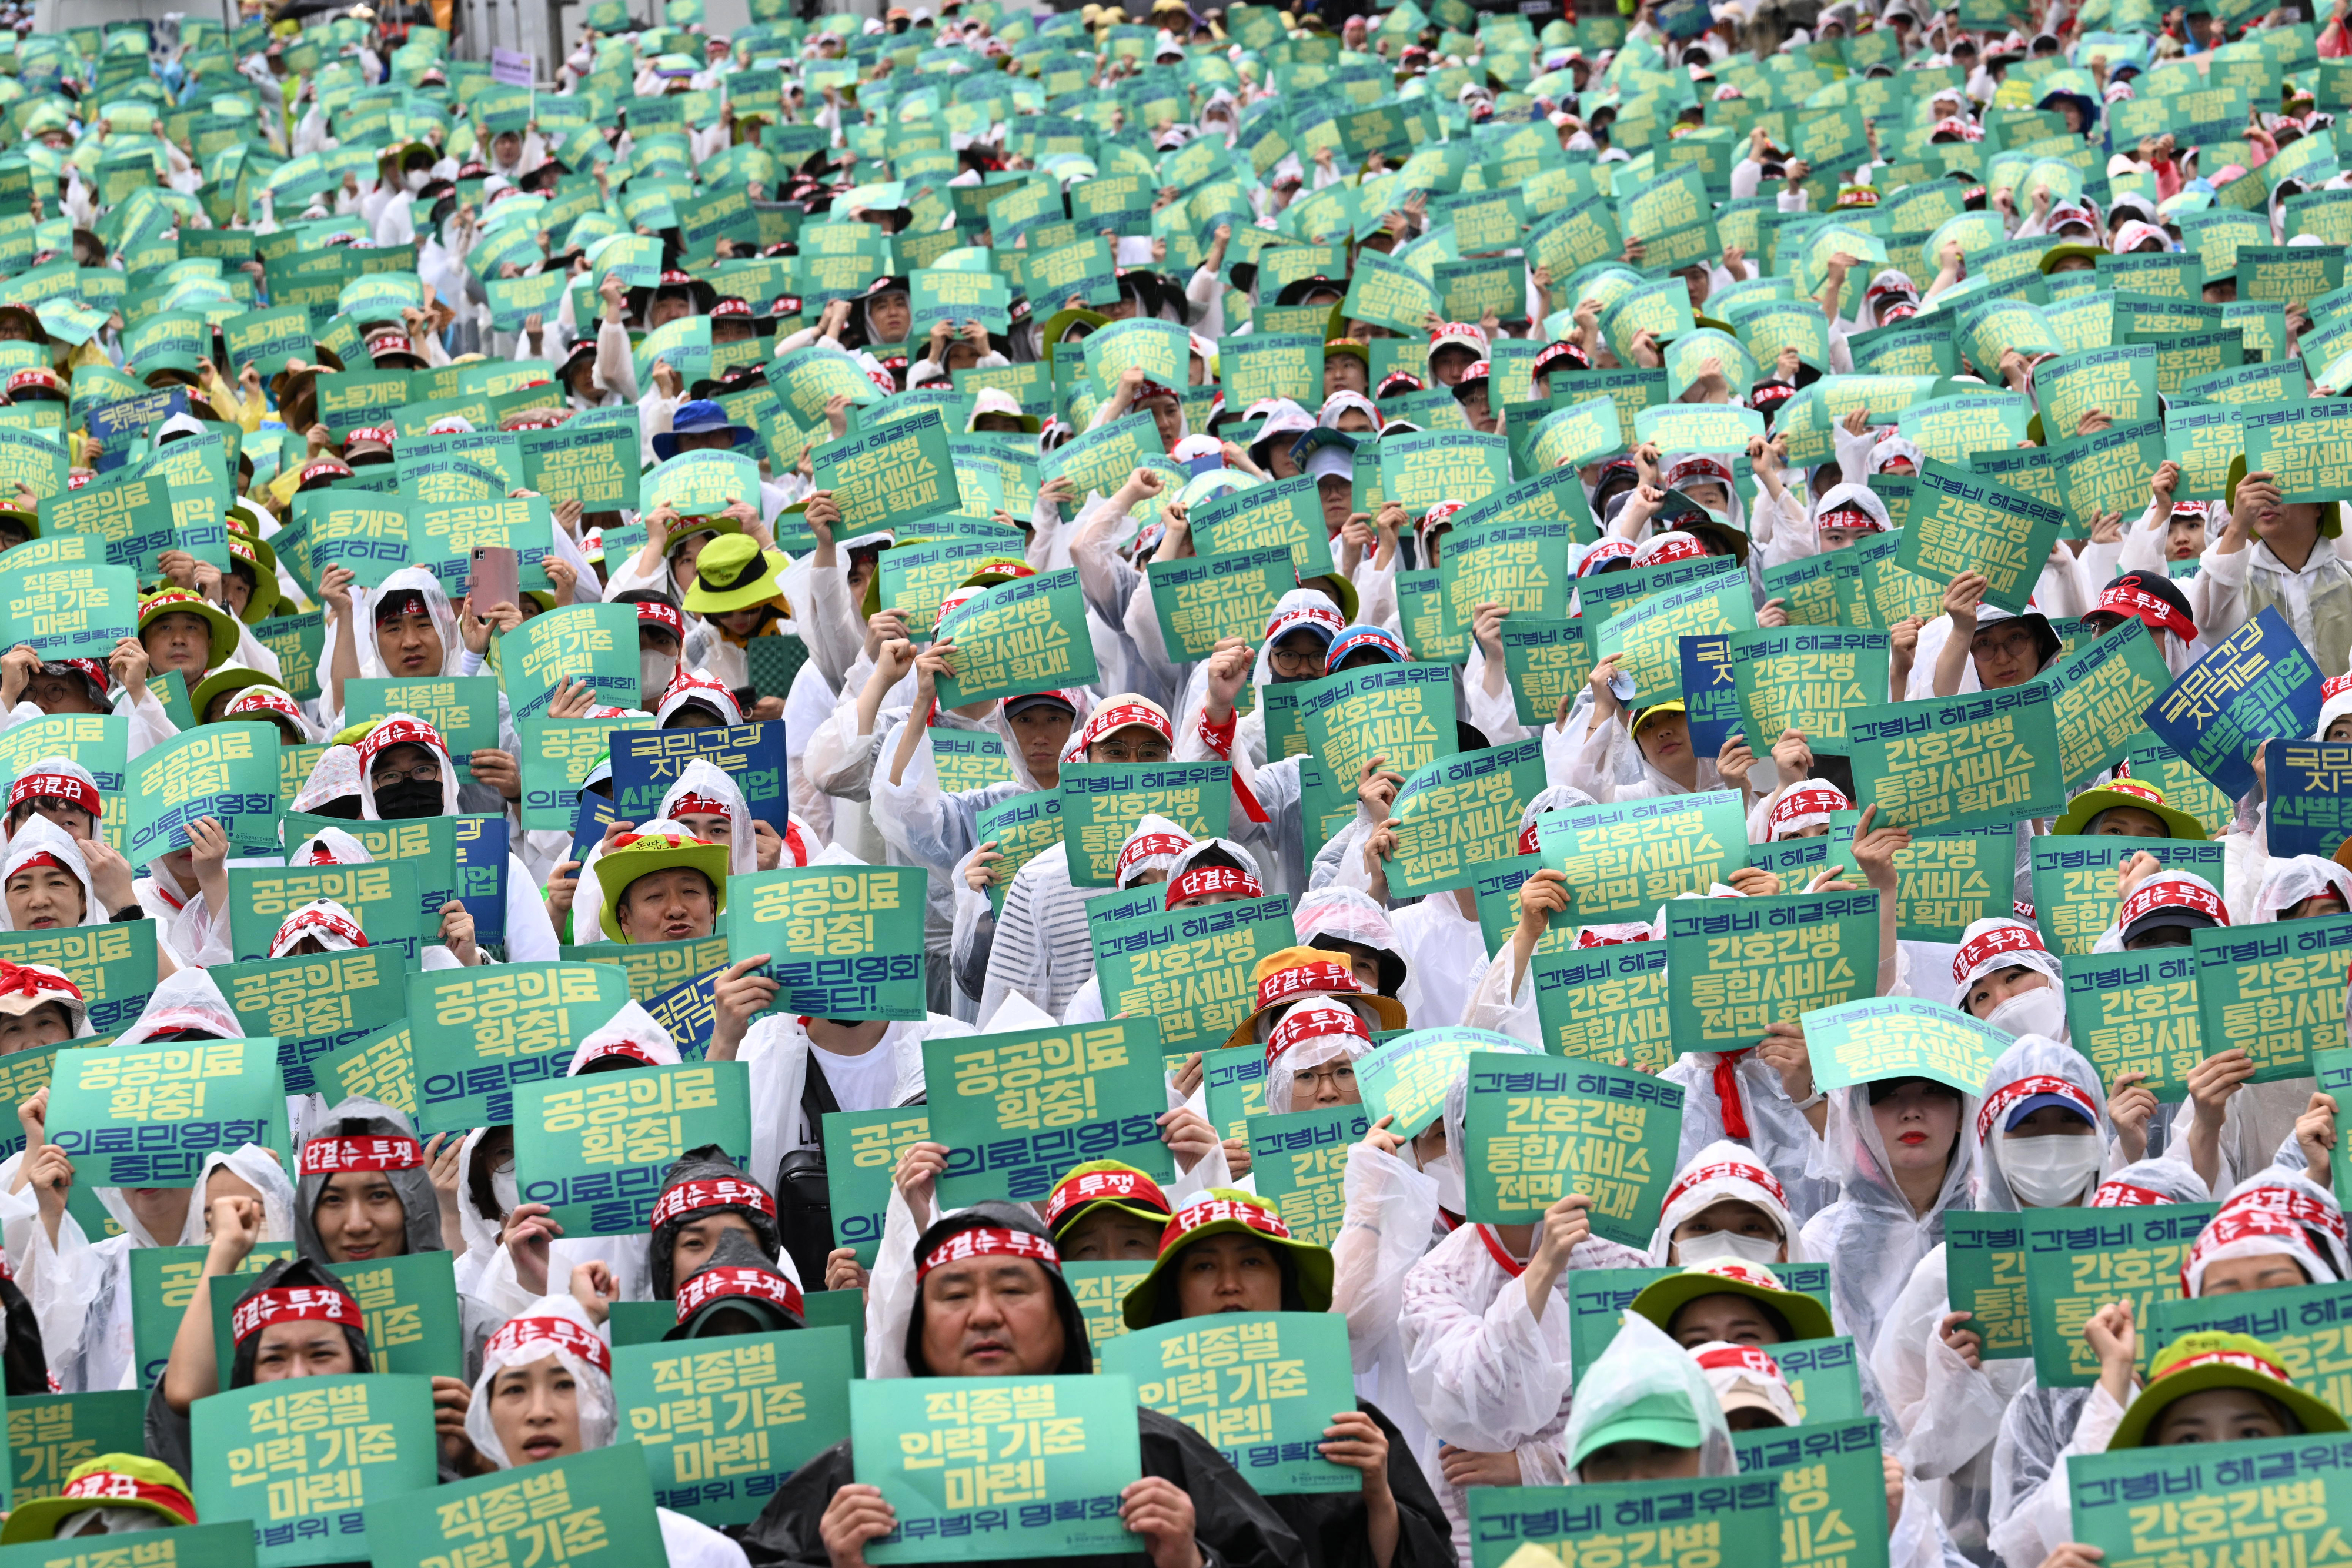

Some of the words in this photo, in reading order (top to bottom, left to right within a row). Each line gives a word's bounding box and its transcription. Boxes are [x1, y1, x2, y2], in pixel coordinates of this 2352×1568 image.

[2134, 314, 2203, 332] 간호간병
[964, 372, 1038, 393] 공공의료
[1238, 349, 1306, 375] 간호간병
[2038, 363, 2085, 385] 간병비
[2055, 363, 2131, 389] 간호간병
[325, 381, 407, 410] 노동개악
[2085, 417, 2166, 454] 해결위한
[2246, 408, 2304, 429] 간병비
[543, 444, 613, 467] 간호간병
[815, 440, 864, 471] 간병비
[869, 408, 941, 447] 해결위한
[836, 436, 920, 483] 간호간병
[834, 456, 938, 510] 통합서비스
[2070, 443, 2141, 484] 간호간병
[53, 482, 150, 529] 공공의료
[1506, 467, 1575, 505] 해결위한
[1922, 470, 1984, 502] 간병비
[1989, 493, 2066, 525] 해결위한
[425, 502, 530, 538] 공공의료
[843, 501, 886, 530] 전면
[889, 484, 939, 514] 확대!
[1936, 496, 2033, 543] 간호간병
[1490, 523, 1568, 542] 해결위한
[1668, 540, 1698, 557] 투쟁
[1918, 517, 2027, 570] 통합서비스
[1152, 566, 1207, 588] 간병비
[1212, 546, 1291, 574] 해결위한
[1458, 541, 1538, 571] 간호간병
[1917, 547, 1963, 575] 전면
[24, 569, 93, 593] 직종별
[988, 570, 1078, 604] 해결위한
[1175, 569, 1266, 604] 간호간병
[1451, 563, 1549, 594] 통합서비스
[10, 593, 56, 620] 인력
[62, 588, 109, 609] 기준
[34, 610, 87, 635] 마련!
[649, 604, 676, 624] 투쟁
[954, 596, 1051, 647] 간호간병
[2132, 592, 2170, 620] 투쟁
[256, 613, 322, 638] 해결위한
[528, 608, 597, 648] 직종별
[565, 630, 613, 658] 기준
[1734, 638, 1788, 663] 간병비
[1796, 634, 1889, 650] 해결위한
[957, 662, 1008, 696] 전면
[1009, 644, 1070, 680] 확대!
[1753, 653, 1855, 688] 간호간병
[2159, 618, 2263, 724] 국민건강
[1302, 681, 1354, 717] 간병비
[1361, 667, 1450, 690] 해결위한
[1325, 688, 1422, 735] 간호간병
[1748, 684, 1867, 721] 통합서비스
[2183, 653, 2270, 730] 지키는
[2190, 648, 2314, 774] 산별총파업
[1852, 713, 1932, 743] 간병비
[1939, 684, 2050, 725] 해결위한
[632, 723, 764, 758] 국민건강
[1885, 715, 2014, 777] 간호간병
[142, 732, 253, 801] 공공의료
[162, 762, 230, 807] 확충!
[1065, 775, 1133, 794] 간병비
[1142, 765, 1231, 787] 해결위한
[1875, 738, 2035, 808] 통합서비스
[1092, 788, 1200, 824] 간호간병
[1544, 810, 1623, 835] 간병비
[1632, 790, 1739, 818] 해결위한
[1881, 793, 1951, 830] 전면
[1957, 773, 2031, 813] 확대!
[1578, 811, 1704, 852] 간호간병
[1564, 837, 1725, 884] 통합서비스
[2036, 849, 2111, 871] 간병비
[253, 867, 391, 915] 공공의료
[754, 872, 900, 929] 공공의료
[1576, 877, 1640, 914] 전면
[2122, 891, 2151, 925] 단결
[2175, 884, 2219, 915] 투쟁
[787, 914, 873, 955] 확충!
[1100, 924, 1174, 958] 간병비
[1182, 898, 1289, 937] 해결위한
[1672, 911, 1759, 937] 간병비
[1769, 894, 1879, 925] 해결위한
[1130, 928, 1256, 991] 간호간병
[1708, 923, 1840, 970] 간호간병
[1986, 930, 2030, 950] 투쟁
[233, 954, 379, 1018] 공공의료
[790, 987, 877, 1015] 중단!
[1265, 969, 1299, 999] 단결
[1692, 952, 1855, 1013] 통합서비스
[268, 995, 353, 1037] 확충!
[1309, 1011, 1355, 1032] 투쟁
[1702, 1004, 1773, 1039] 전면
[79, 1044, 244, 1090] 공공의료
[955, 1026, 1128, 1103] 공공의료
[109, 1081, 205, 1121] 확충!
[994, 1071, 1097, 1129] 확충!
[1474, 1072, 1566, 1093] 간병비
[1577, 1074, 1684, 1110] 해결위한
[52, 1120, 269, 1156] 의료민영화
[1501, 1096, 1646, 1144] 간호간병
[305, 1141, 339, 1170] 단결
[368, 1141, 413, 1168] 투쟁
[1488, 1134, 1650, 1189] 통합서비스
[1079, 1175, 1134, 1195] 투쟁
[1498, 1176, 1562, 1211] 전면
[1161, 1322, 1280, 1369] 직종별
[1227, 1360, 1307, 1402] 기준
[249, 1384, 369, 1435] 직종별
[926, 1385, 1057, 1426] 직종별
[228, 1435, 308, 1488] 인력
[316, 1424, 397, 1467] 기준
[900, 1426, 988, 1471] 인력
[998, 1417, 1085, 1457] 기준
[268, 1467, 363, 1520] 마련!
[945, 1459, 1045, 1509] 마련!
[2076, 1465, 2202, 1509] 간병비
[437, 1469, 572, 1547] 직종별
[1478, 1504, 1601, 1542] 간병비
[1616, 1480, 1779, 1526] 해결위한
